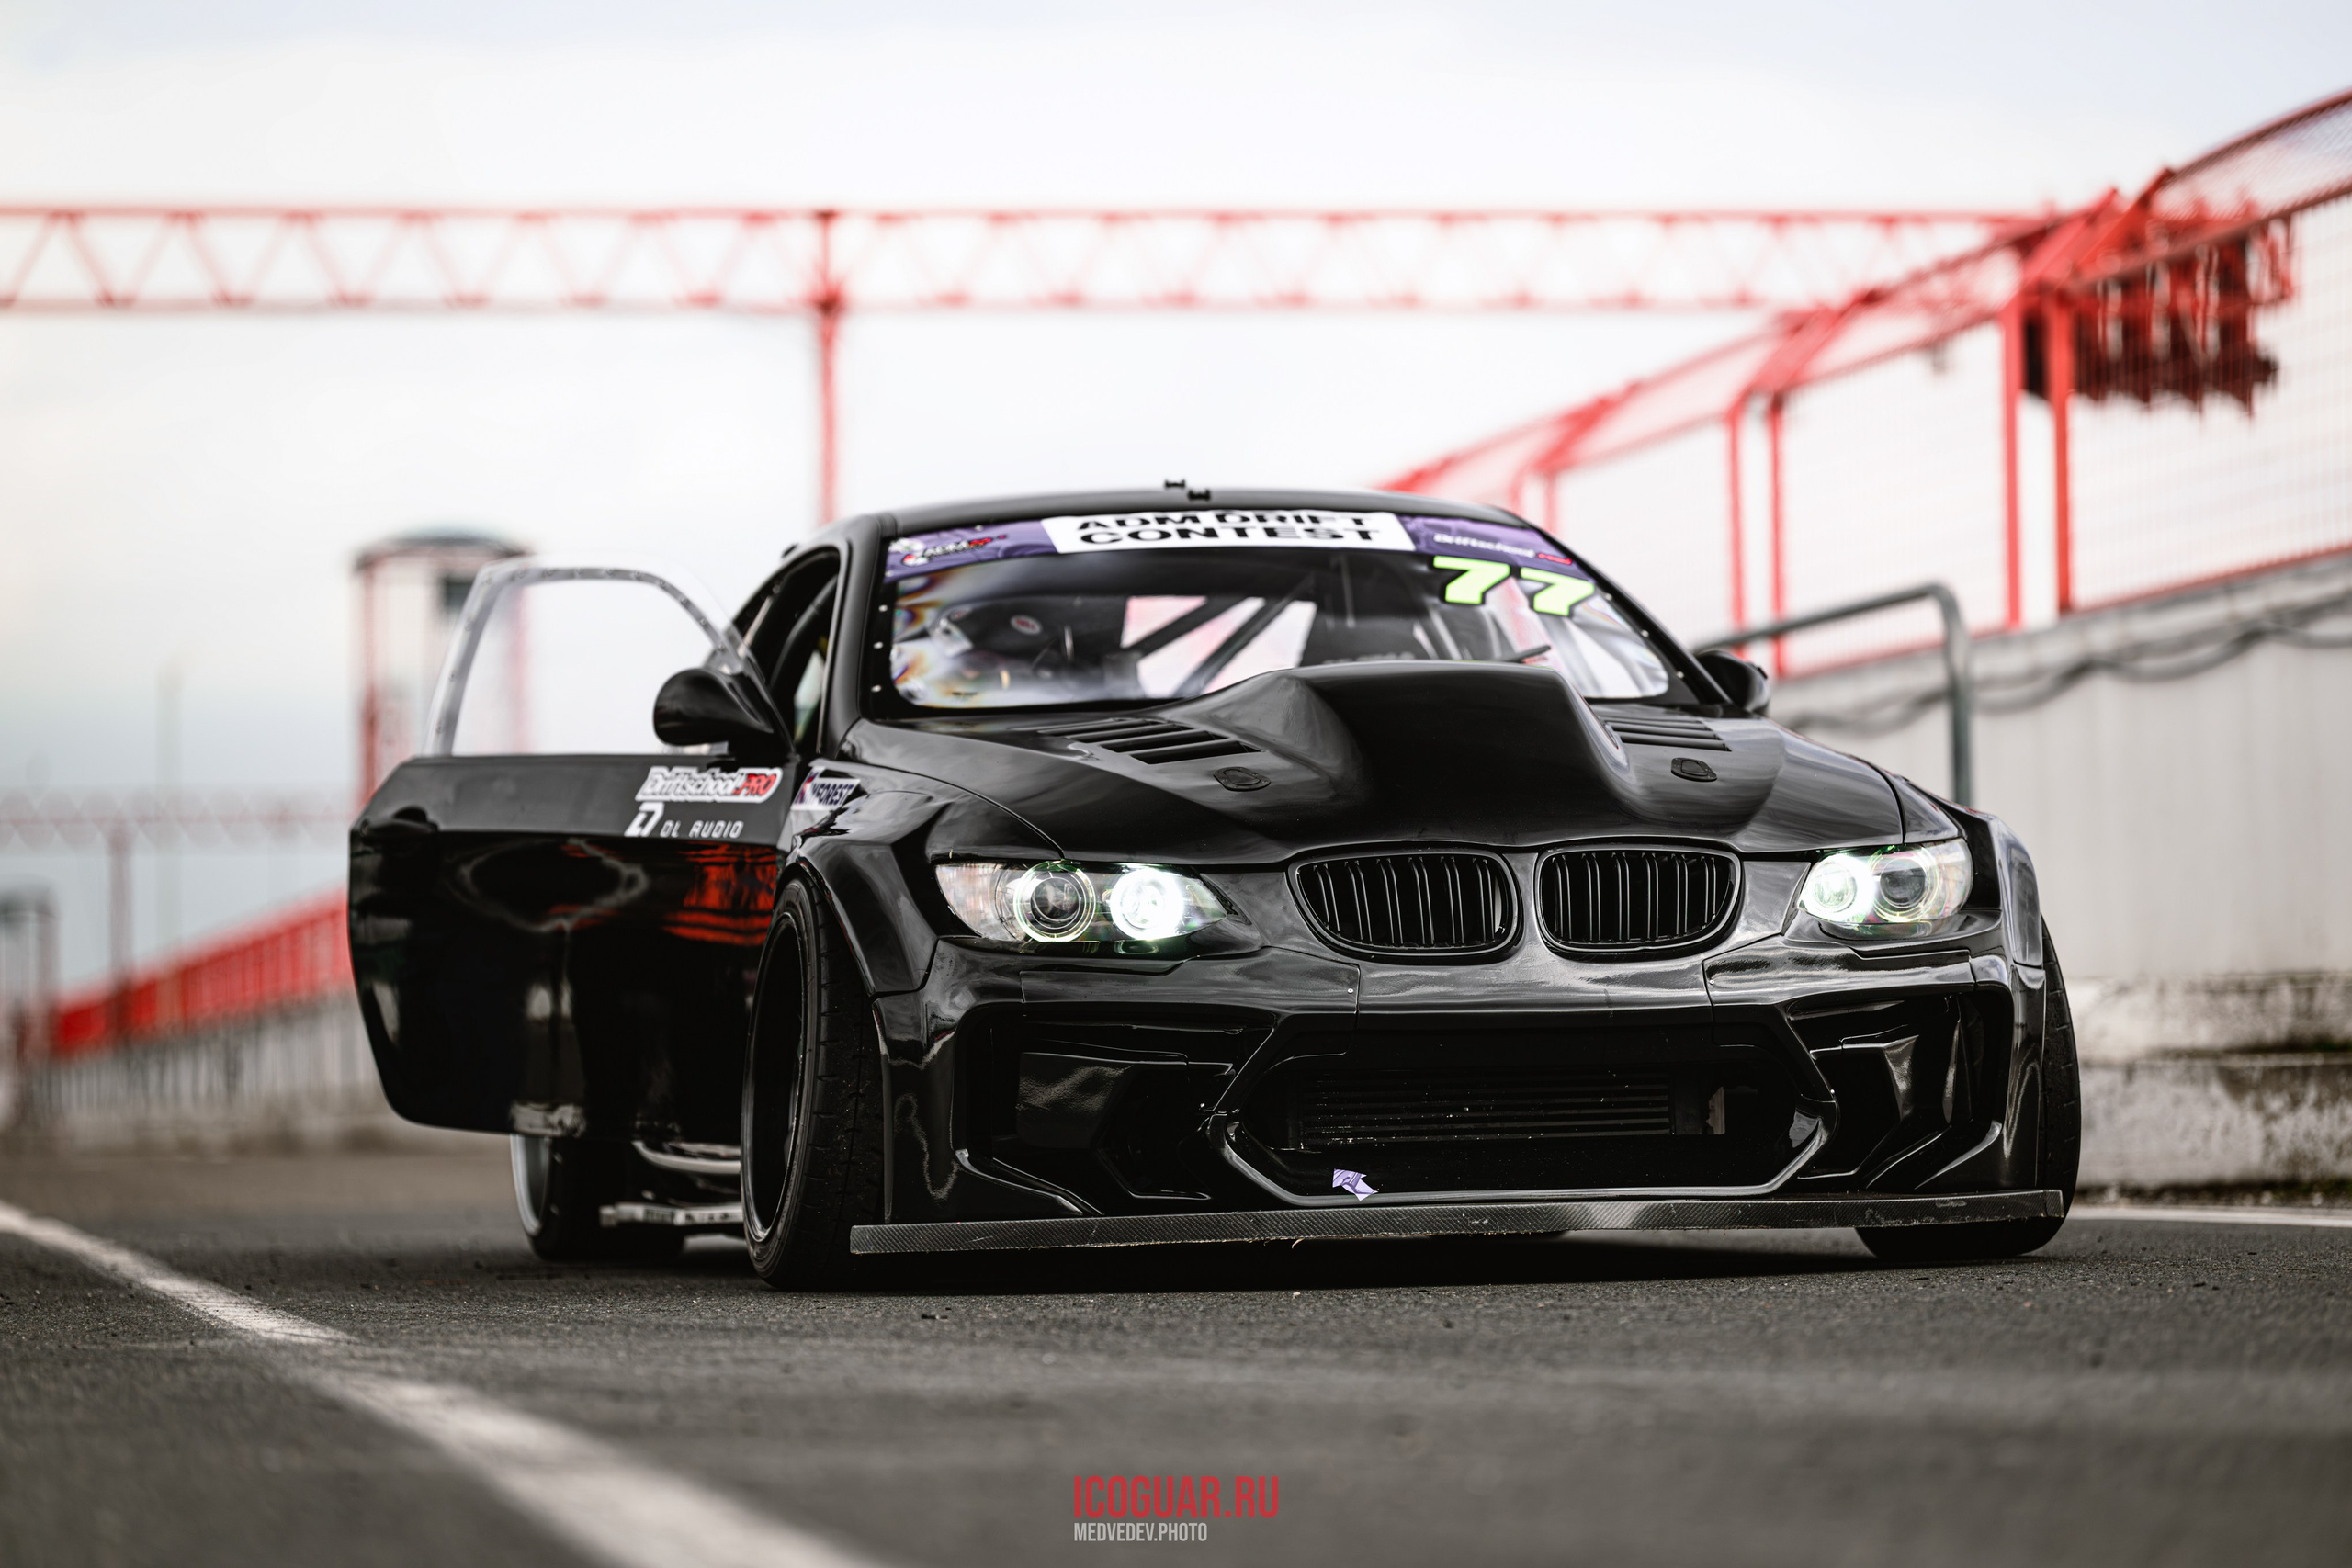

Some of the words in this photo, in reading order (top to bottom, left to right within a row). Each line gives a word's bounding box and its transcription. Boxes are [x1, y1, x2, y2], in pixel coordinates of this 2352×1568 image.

[1077, 513, 1201, 530] ADM
[1215, 511, 1373, 526] DRIFT
[1080, 525, 1380, 545] CONTEST
[1432, 555, 1595, 616] 77
[689, 819, 744, 838] AUDIO
